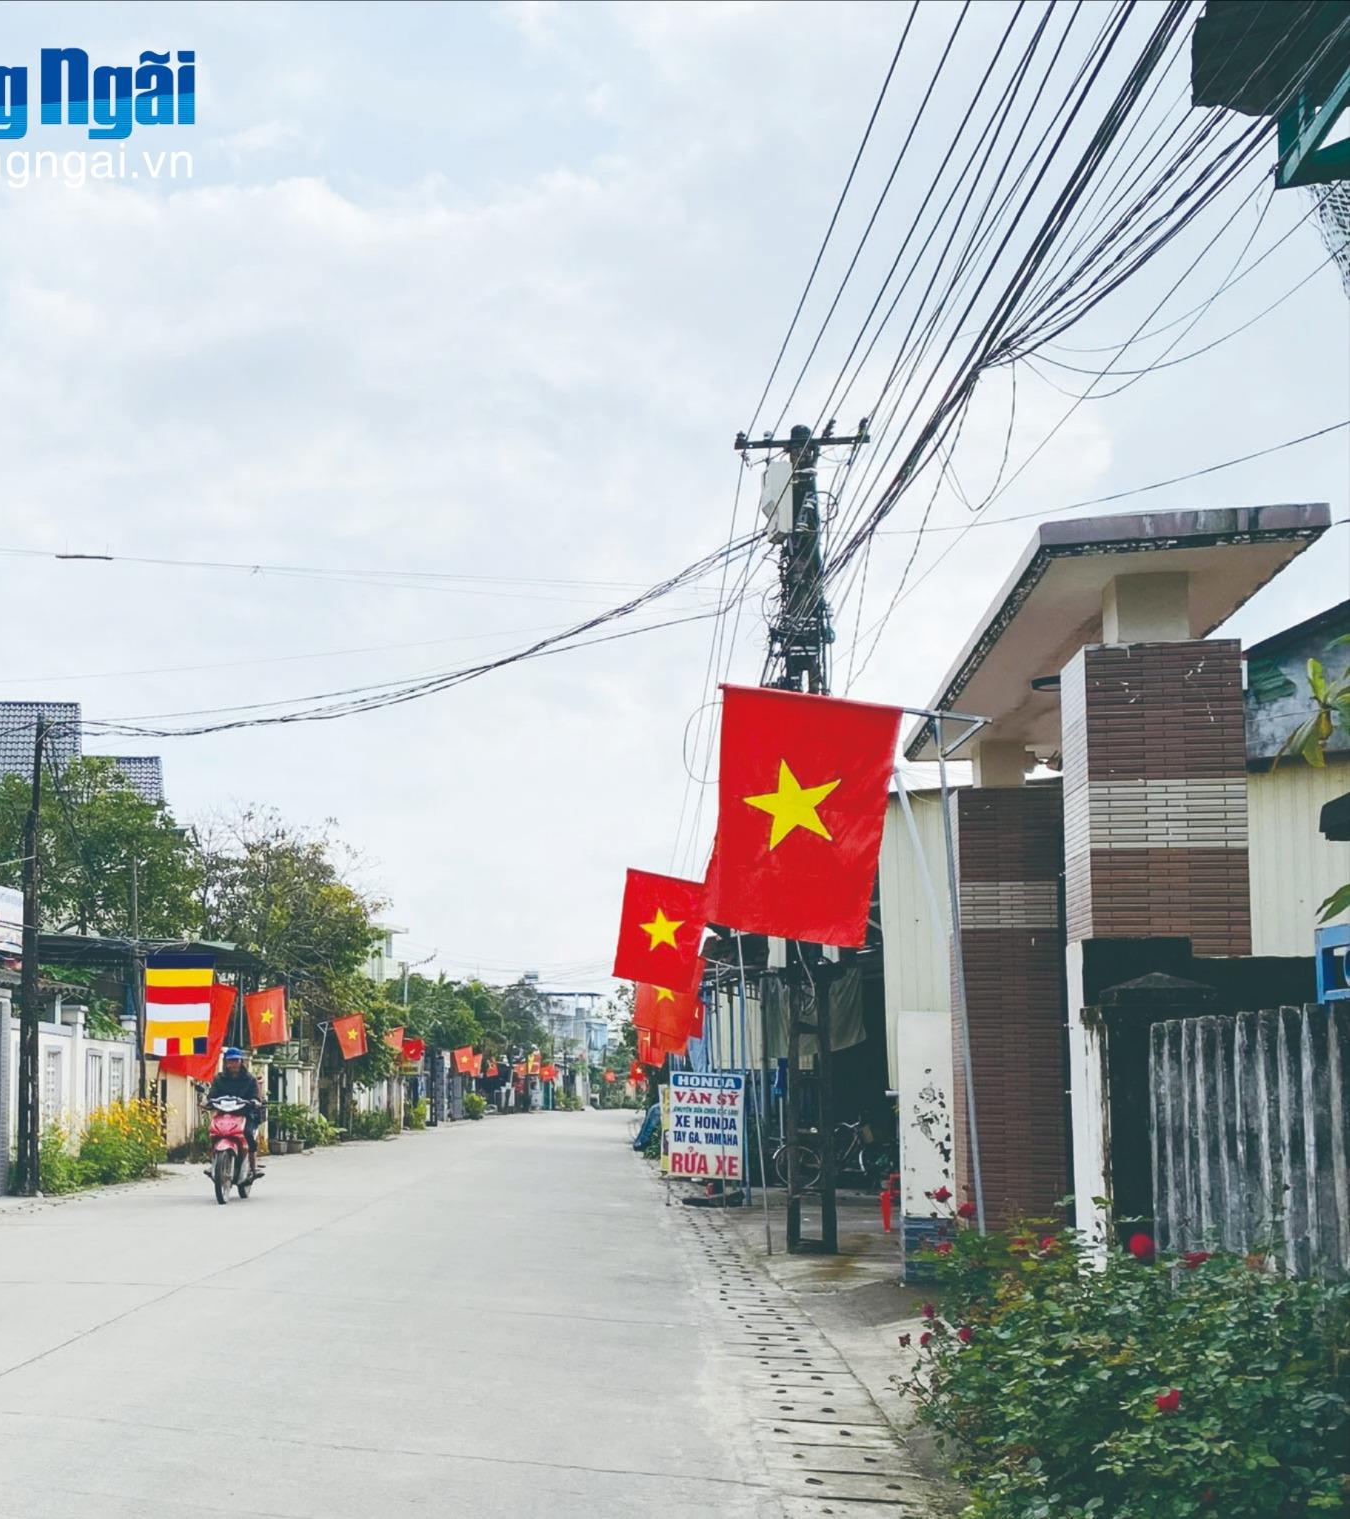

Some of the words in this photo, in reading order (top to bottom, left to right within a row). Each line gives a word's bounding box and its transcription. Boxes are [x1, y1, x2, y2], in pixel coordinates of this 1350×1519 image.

[677, 1075, 736, 1088] HONDA
[674, 1089, 712, 1104] VĂN
[716, 1091, 739, 1106] SỸ
[675, 1115, 691, 1128] XE
[694, 1115, 737, 1130] HONDA
[673, 1130, 687, 1142] TAY
[704, 1132, 738, 1146] YAMAHA
[671, 1146, 708, 1175] RỬA
[715, 1155, 739, 1176] XE
